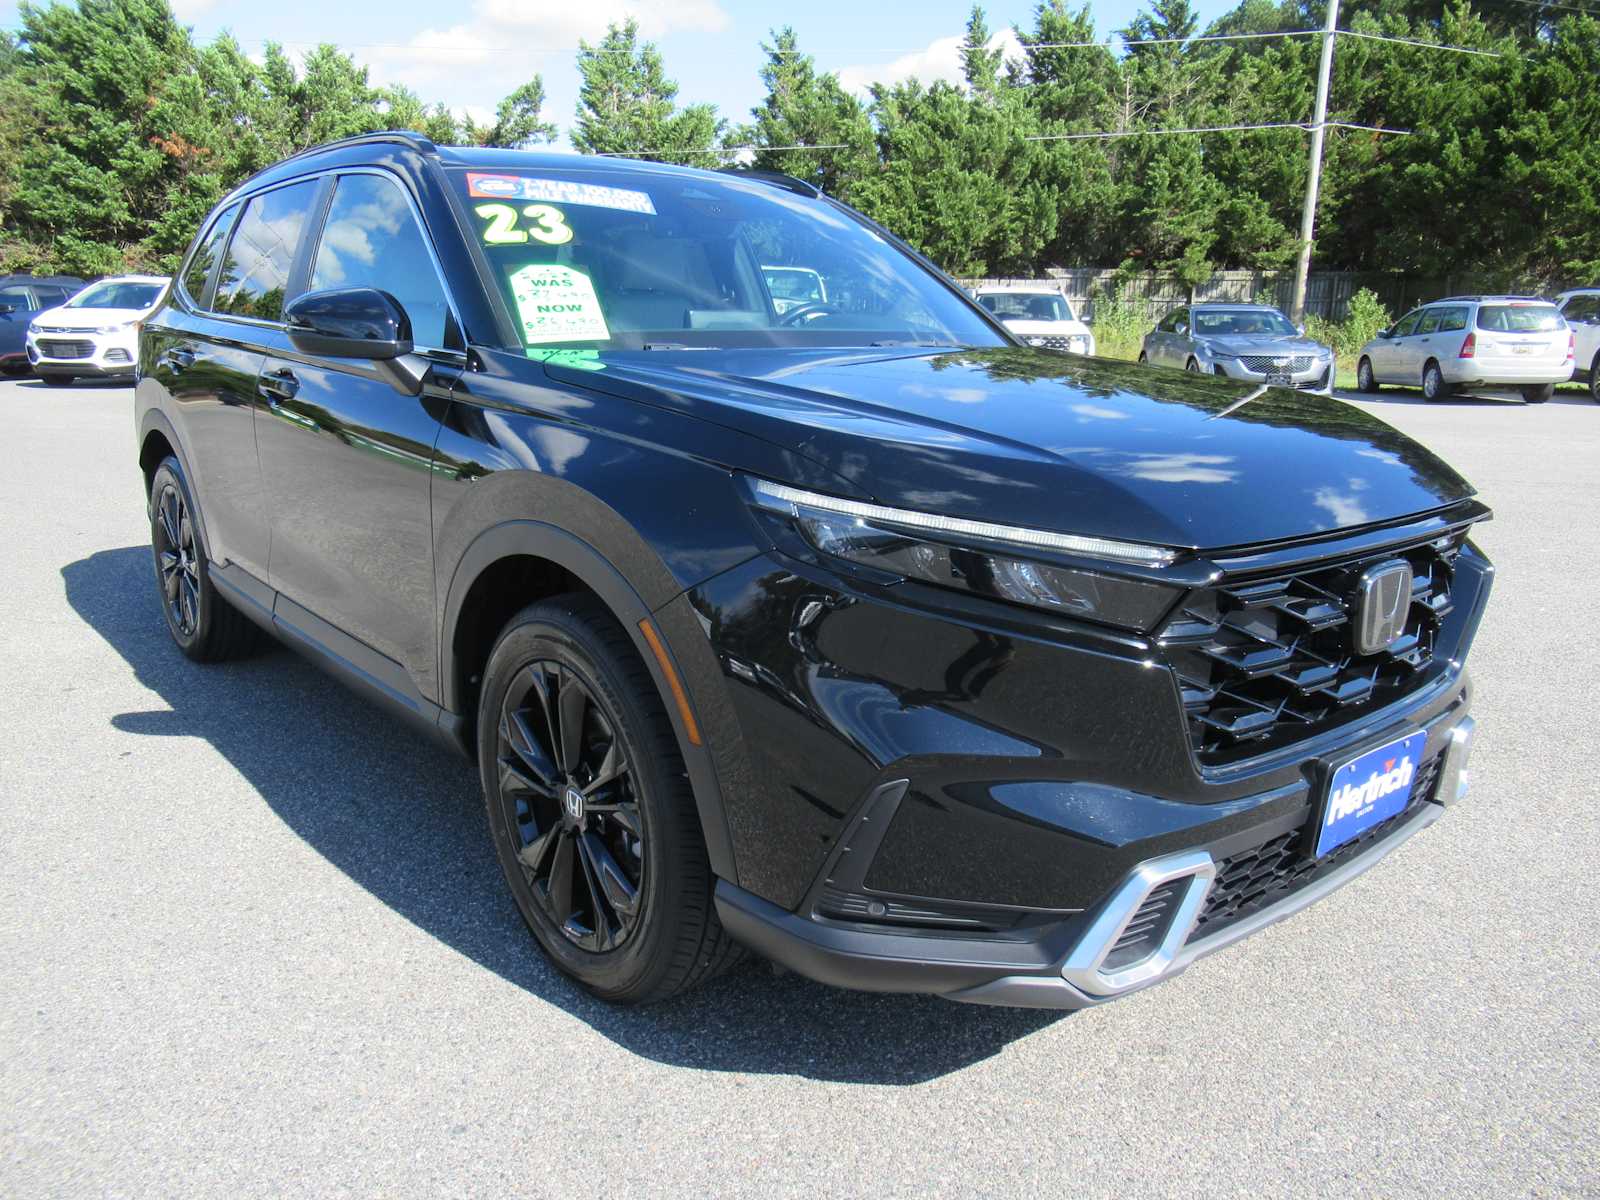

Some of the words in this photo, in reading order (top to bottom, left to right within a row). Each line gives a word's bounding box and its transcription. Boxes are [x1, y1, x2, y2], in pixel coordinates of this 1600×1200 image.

[474, 203, 574, 244] 23
[531, 279, 574, 287] WAS
[537, 304, 582, 312] NOW
[1327, 755, 1414, 826] Hertrich
